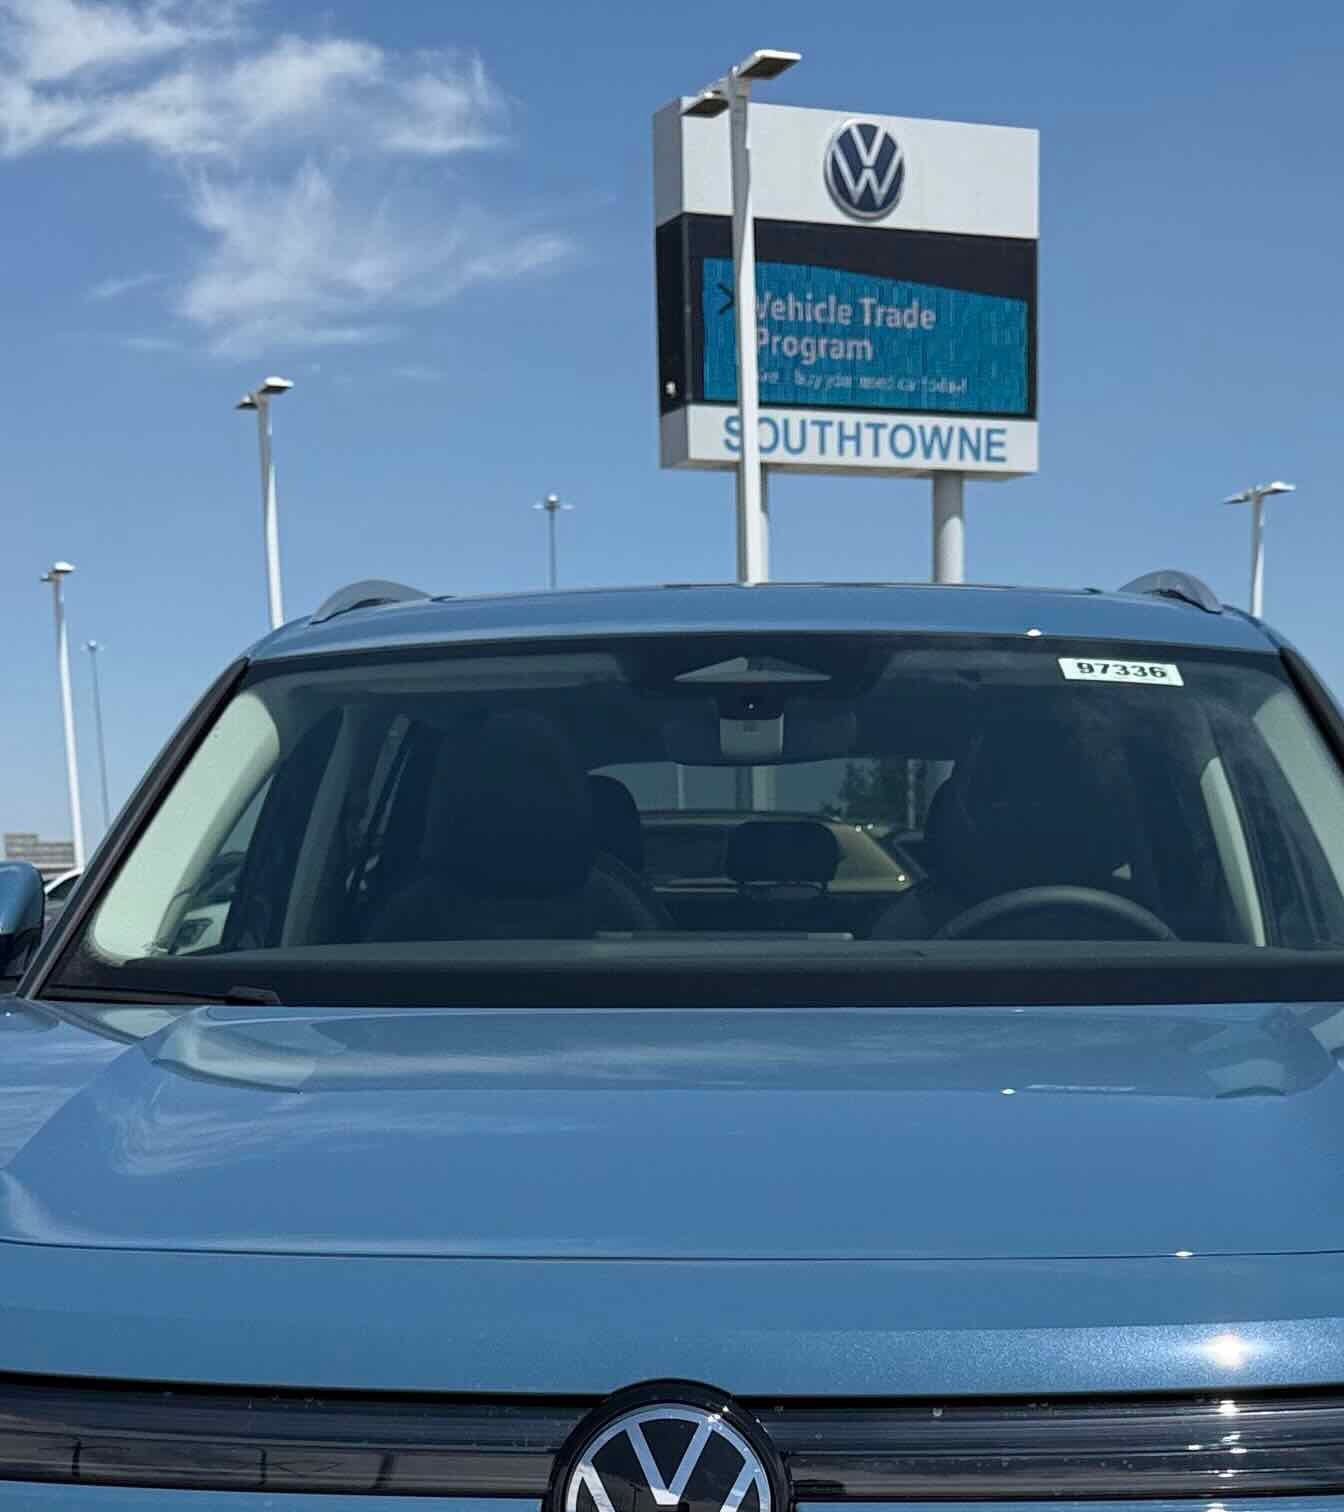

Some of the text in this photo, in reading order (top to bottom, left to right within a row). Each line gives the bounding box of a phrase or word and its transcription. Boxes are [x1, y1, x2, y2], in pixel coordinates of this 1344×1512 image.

[824, 118, 906, 222] VW
[857, 296, 937, 330] Trade
[758, 327, 873, 365] Program
[723, 415, 1008, 464] SOUTHTOWNE
[1076, 661, 1167, 678] 97336
